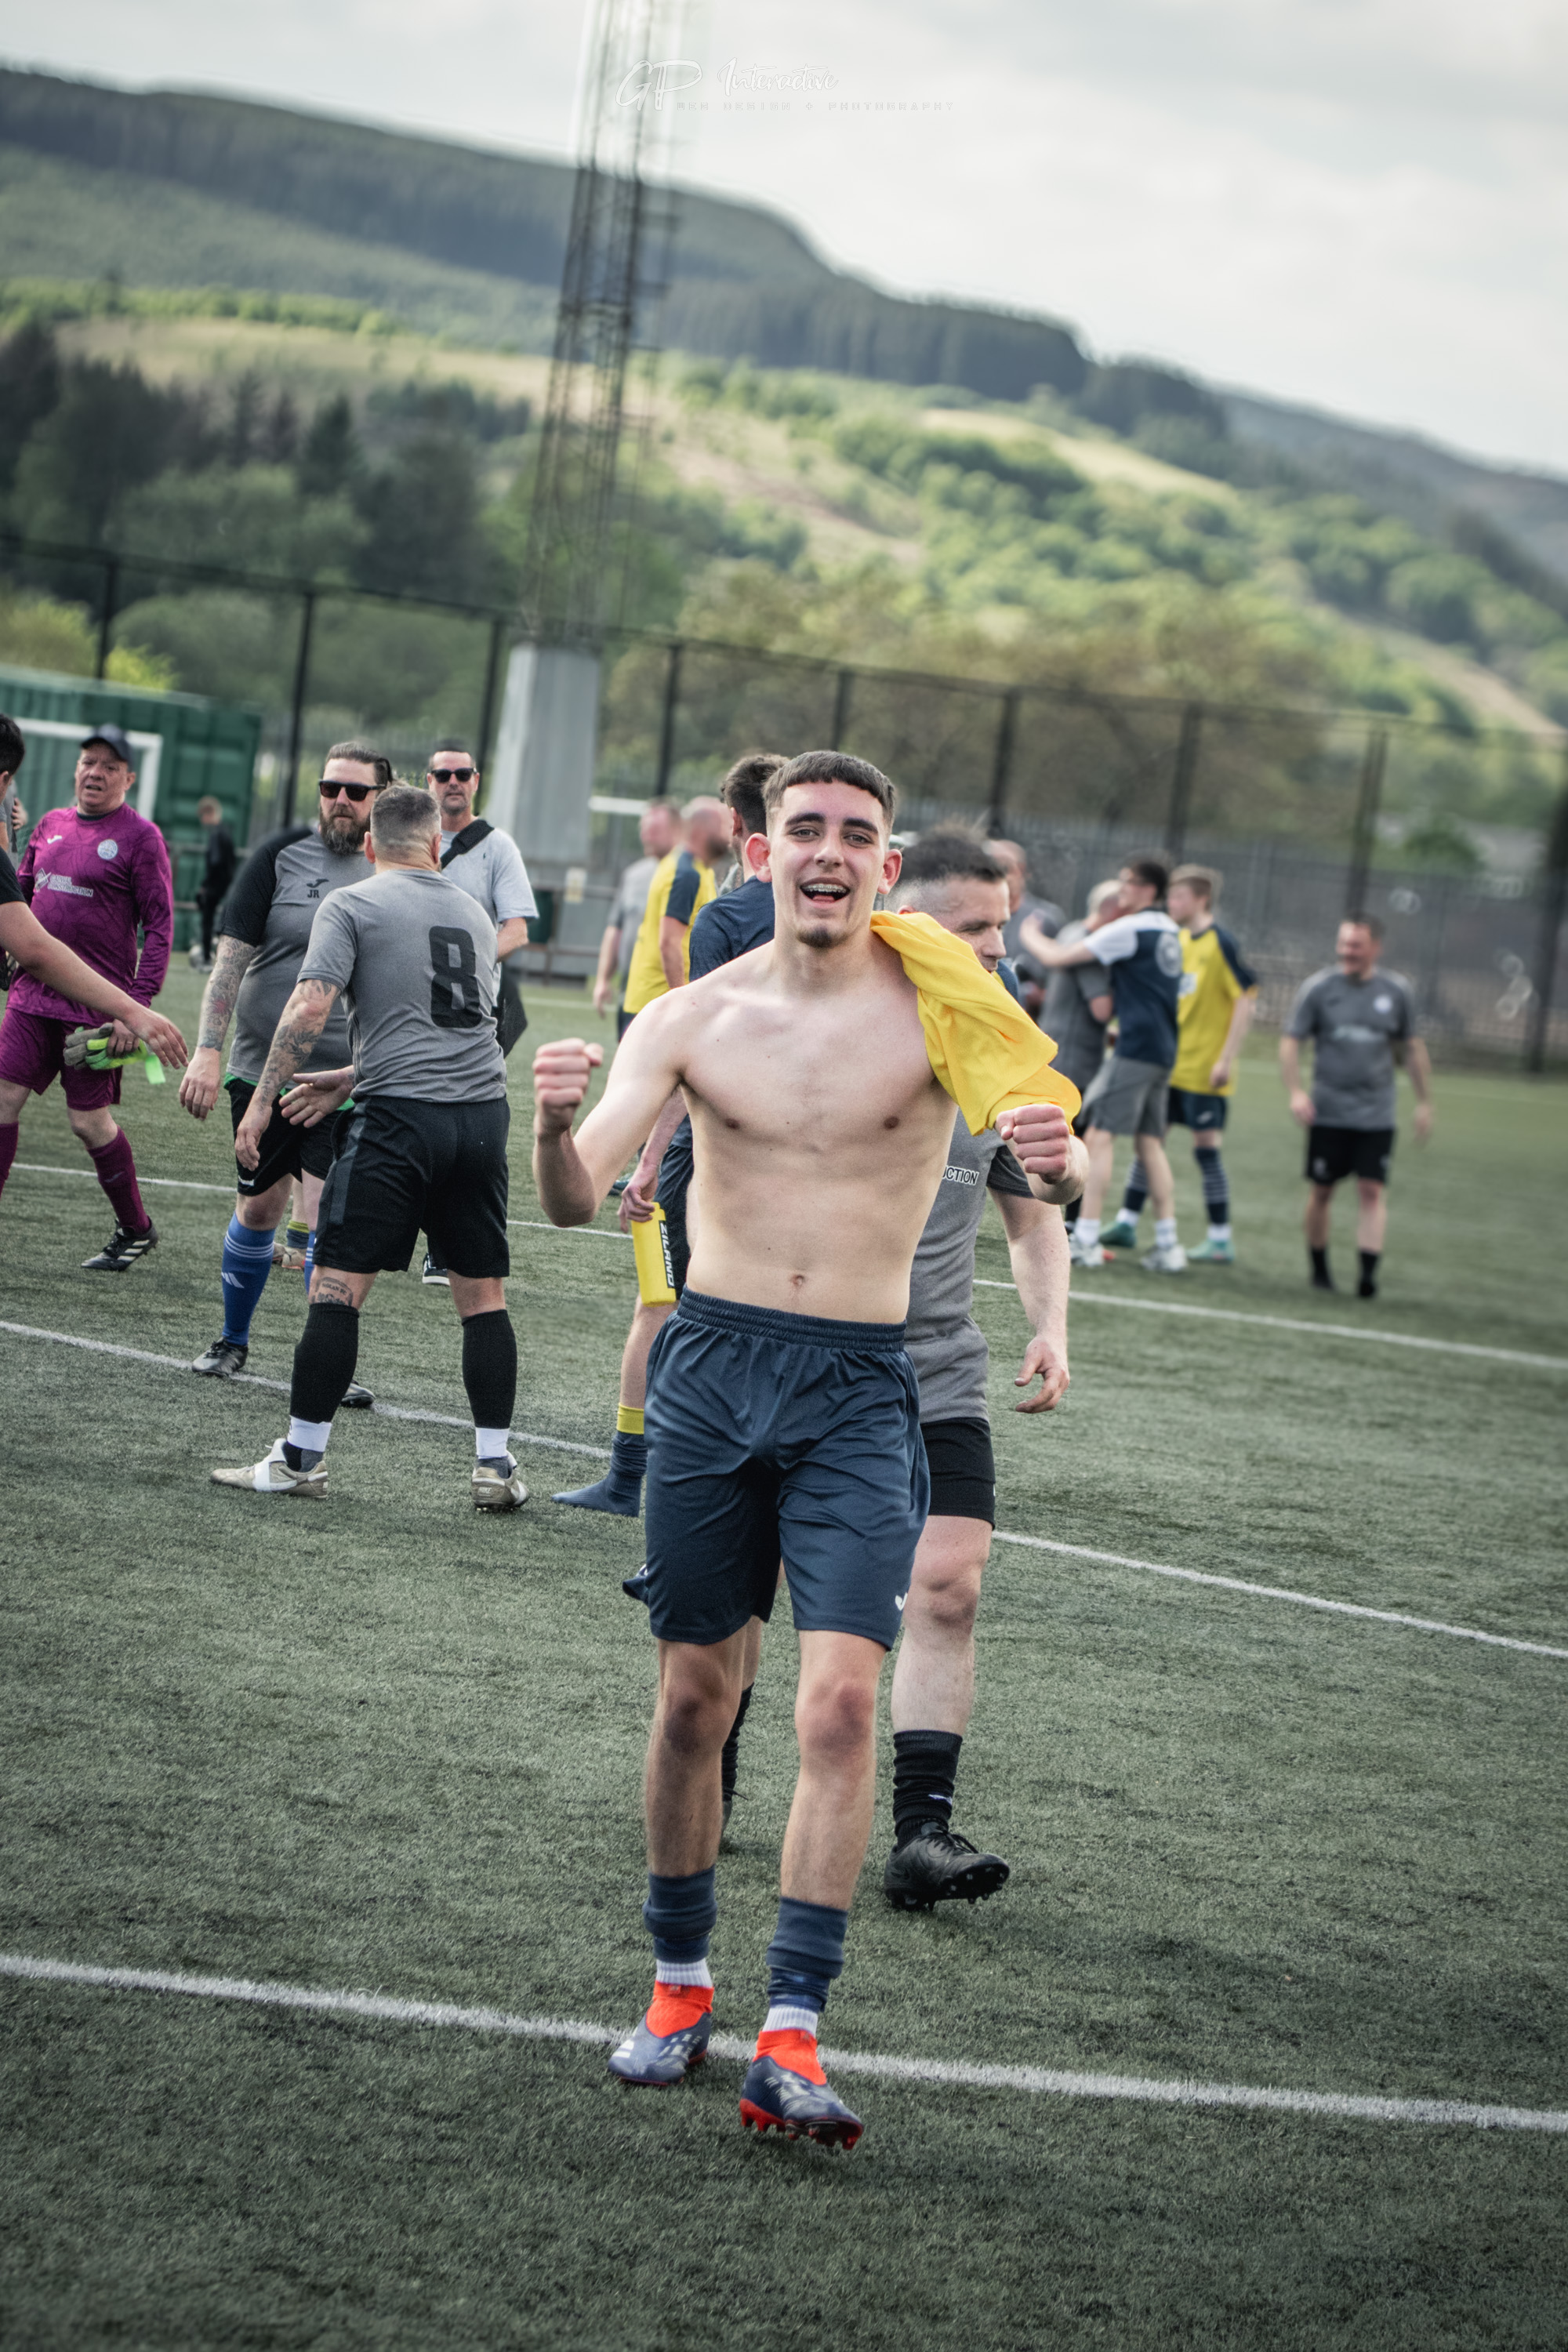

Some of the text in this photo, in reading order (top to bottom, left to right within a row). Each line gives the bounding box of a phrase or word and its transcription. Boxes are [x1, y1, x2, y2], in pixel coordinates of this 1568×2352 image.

[307, 890, 319, 898] JR
[429, 925, 483, 1029] 8
[659, 1222, 675, 1287] ZILAND
